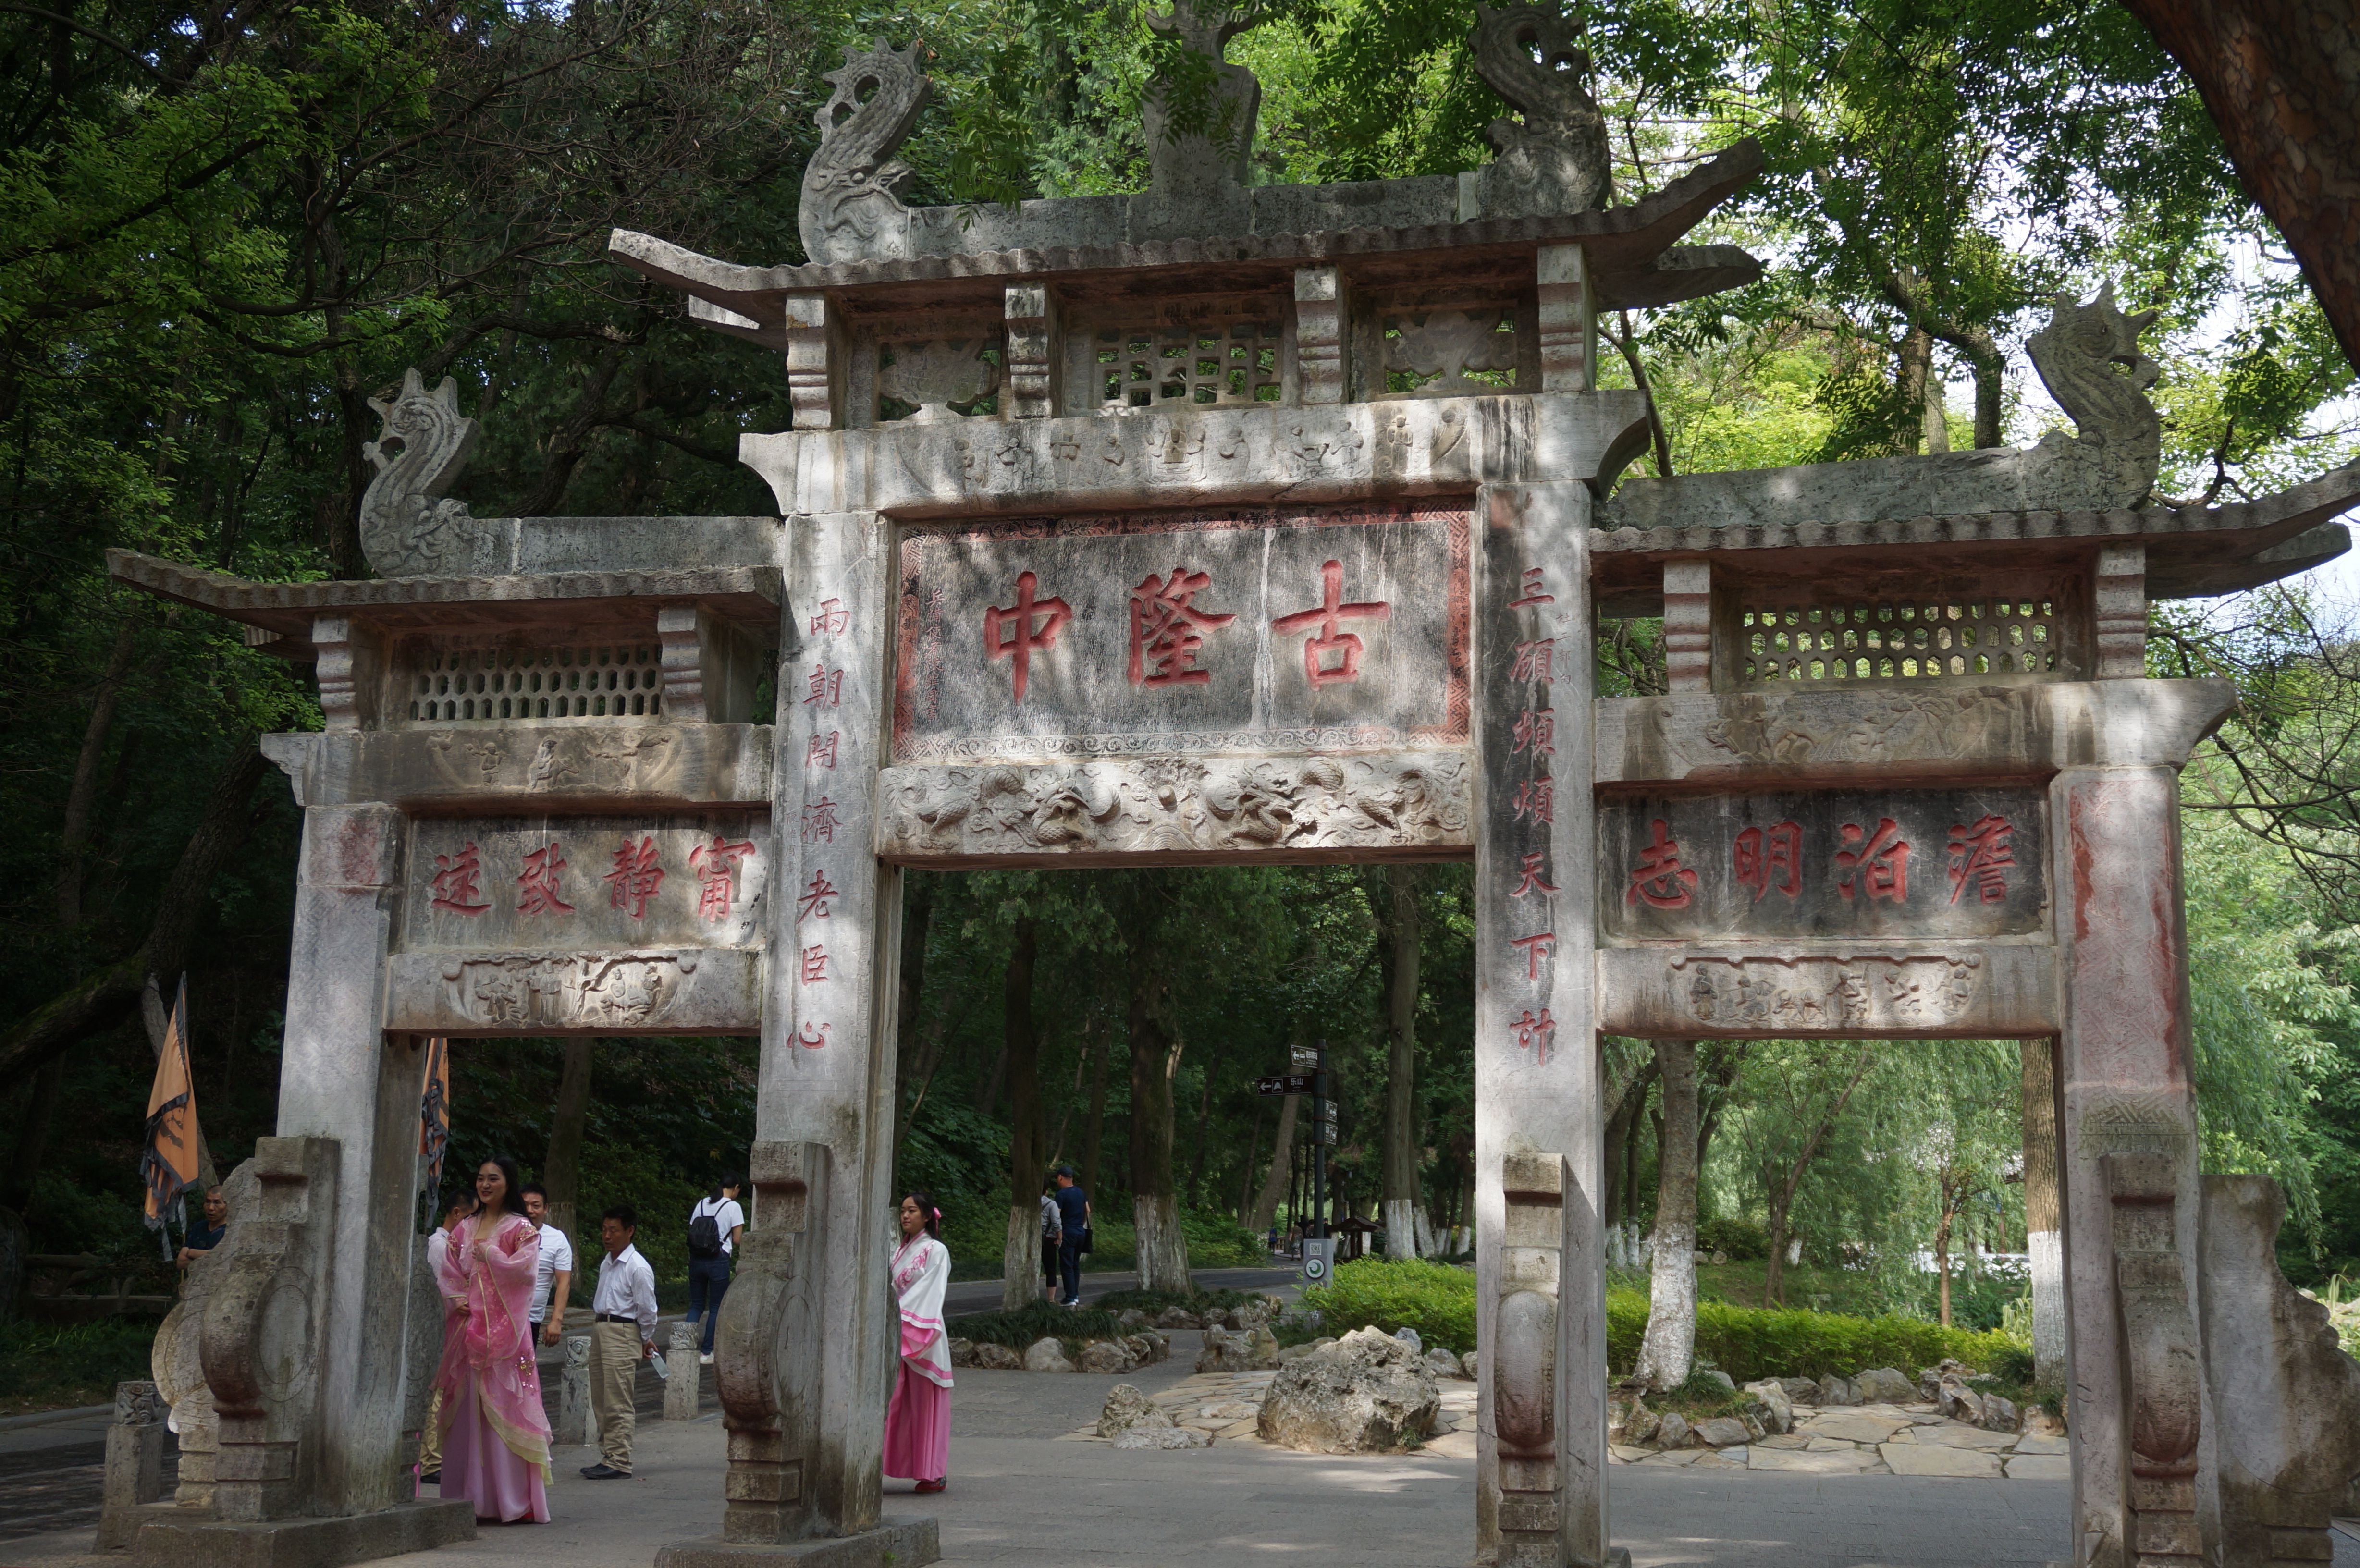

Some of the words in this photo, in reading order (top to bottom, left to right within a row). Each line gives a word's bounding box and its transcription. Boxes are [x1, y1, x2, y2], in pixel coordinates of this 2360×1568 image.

[984, 559, 1391, 705] 古隆中
[787, 599, 850, 1049] 兩朝開濟老臣心
[1627, 814, 2016, 909] 澹泊明志
[1291, 1077, 1303, 1086] 乐山
